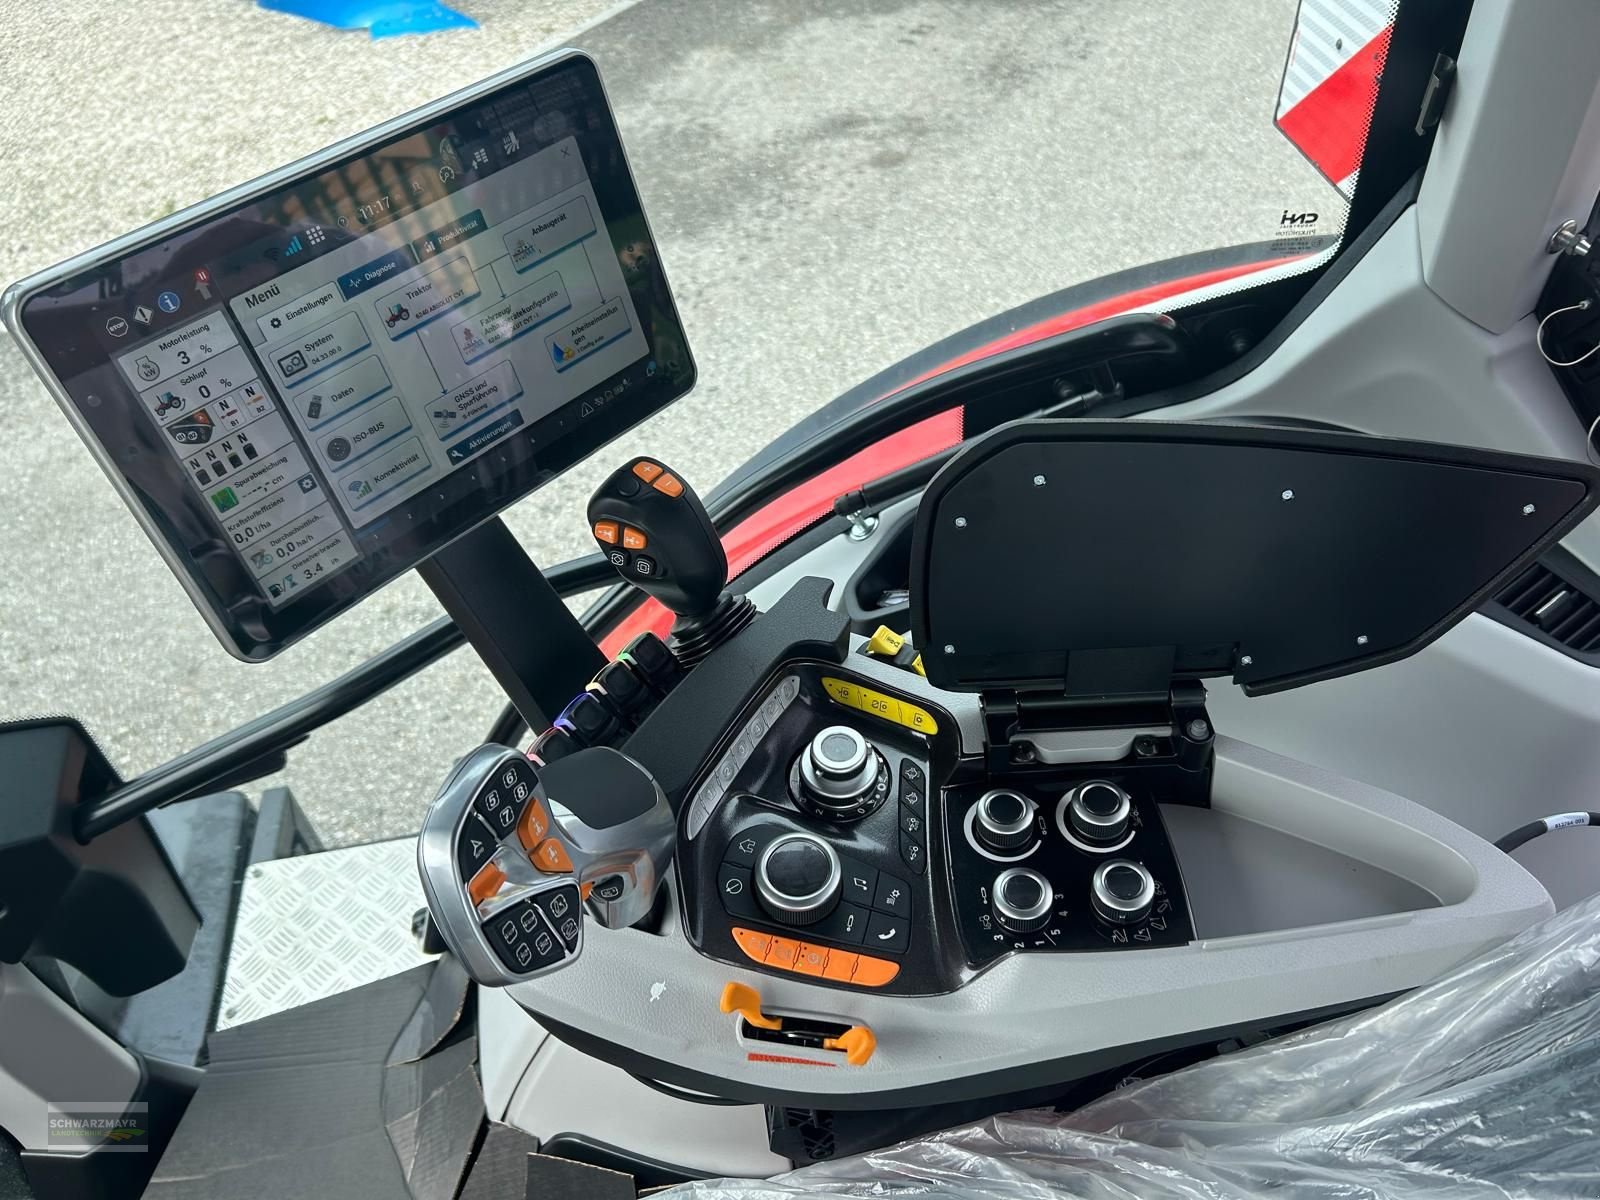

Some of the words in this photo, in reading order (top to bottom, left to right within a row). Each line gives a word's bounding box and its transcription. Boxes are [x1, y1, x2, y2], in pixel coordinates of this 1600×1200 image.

[359, 195, 390, 220] 11:17
[438, 220, 479, 244] Produktivität
[531, 213, 567, 236] Anbaugerät
[364, 261, 396, 281] Diagnose
[244, 283, 281, 309] Menü
[405, 283, 433, 300] Traktor
[285, 291, 334, 321] Einstellungen
[480, 304, 512, 327] Fahrzeug/
[109, 321, 125, 332] STOP
[158, 324, 210, 352] Motorleistung
[304, 333, 334, 352] System
[574, 334, 586, 346] gen
[177, 350, 191, 365] 3
[200, 344, 212, 354] %
[180, 368, 208, 386] Schlupf
[198, 385, 211, 399] 0
[220, 378, 232, 388] %
[244, 386, 256, 397] N
[330, 386, 355, 403] Daten
[454, 384, 476, 404] GNSS
[472, 380, 488, 393] und
[457, 384, 499, 412] Spurführung
[218, 400, 230, 411] N
[256, 406, 265, 414] B2
[352, 421, 386, 444] ISO-BUS
[468, 420, 513, 450] Aktivierungen
[189, 458, 201, 470] N
[206, 450, 217, 462] N
[222, 440, 233, 452] N
[237, 432, 248, 444] N
[234, 456, 288, 488] Spurabweichung
[373, 452, 421, 484] Konnektivität
[271, 474, 284, 485] cm
[227, 496, 286, 532] Kraftstoffeffizienz
[234, 527, 255, 544] 0,0
[276, 542, 296, 559] 0,0
[296, 534, 314, 548] ha/h
[292, 538, 341, 570] Dieselverbrauch
[304, 562, 324, 580] 3.4
[506, 773, 514, 784] 6
[489, 794, 496, 806] 5
[517, 786, 525, 798] 8
[503, 809, 509, 822] 7
